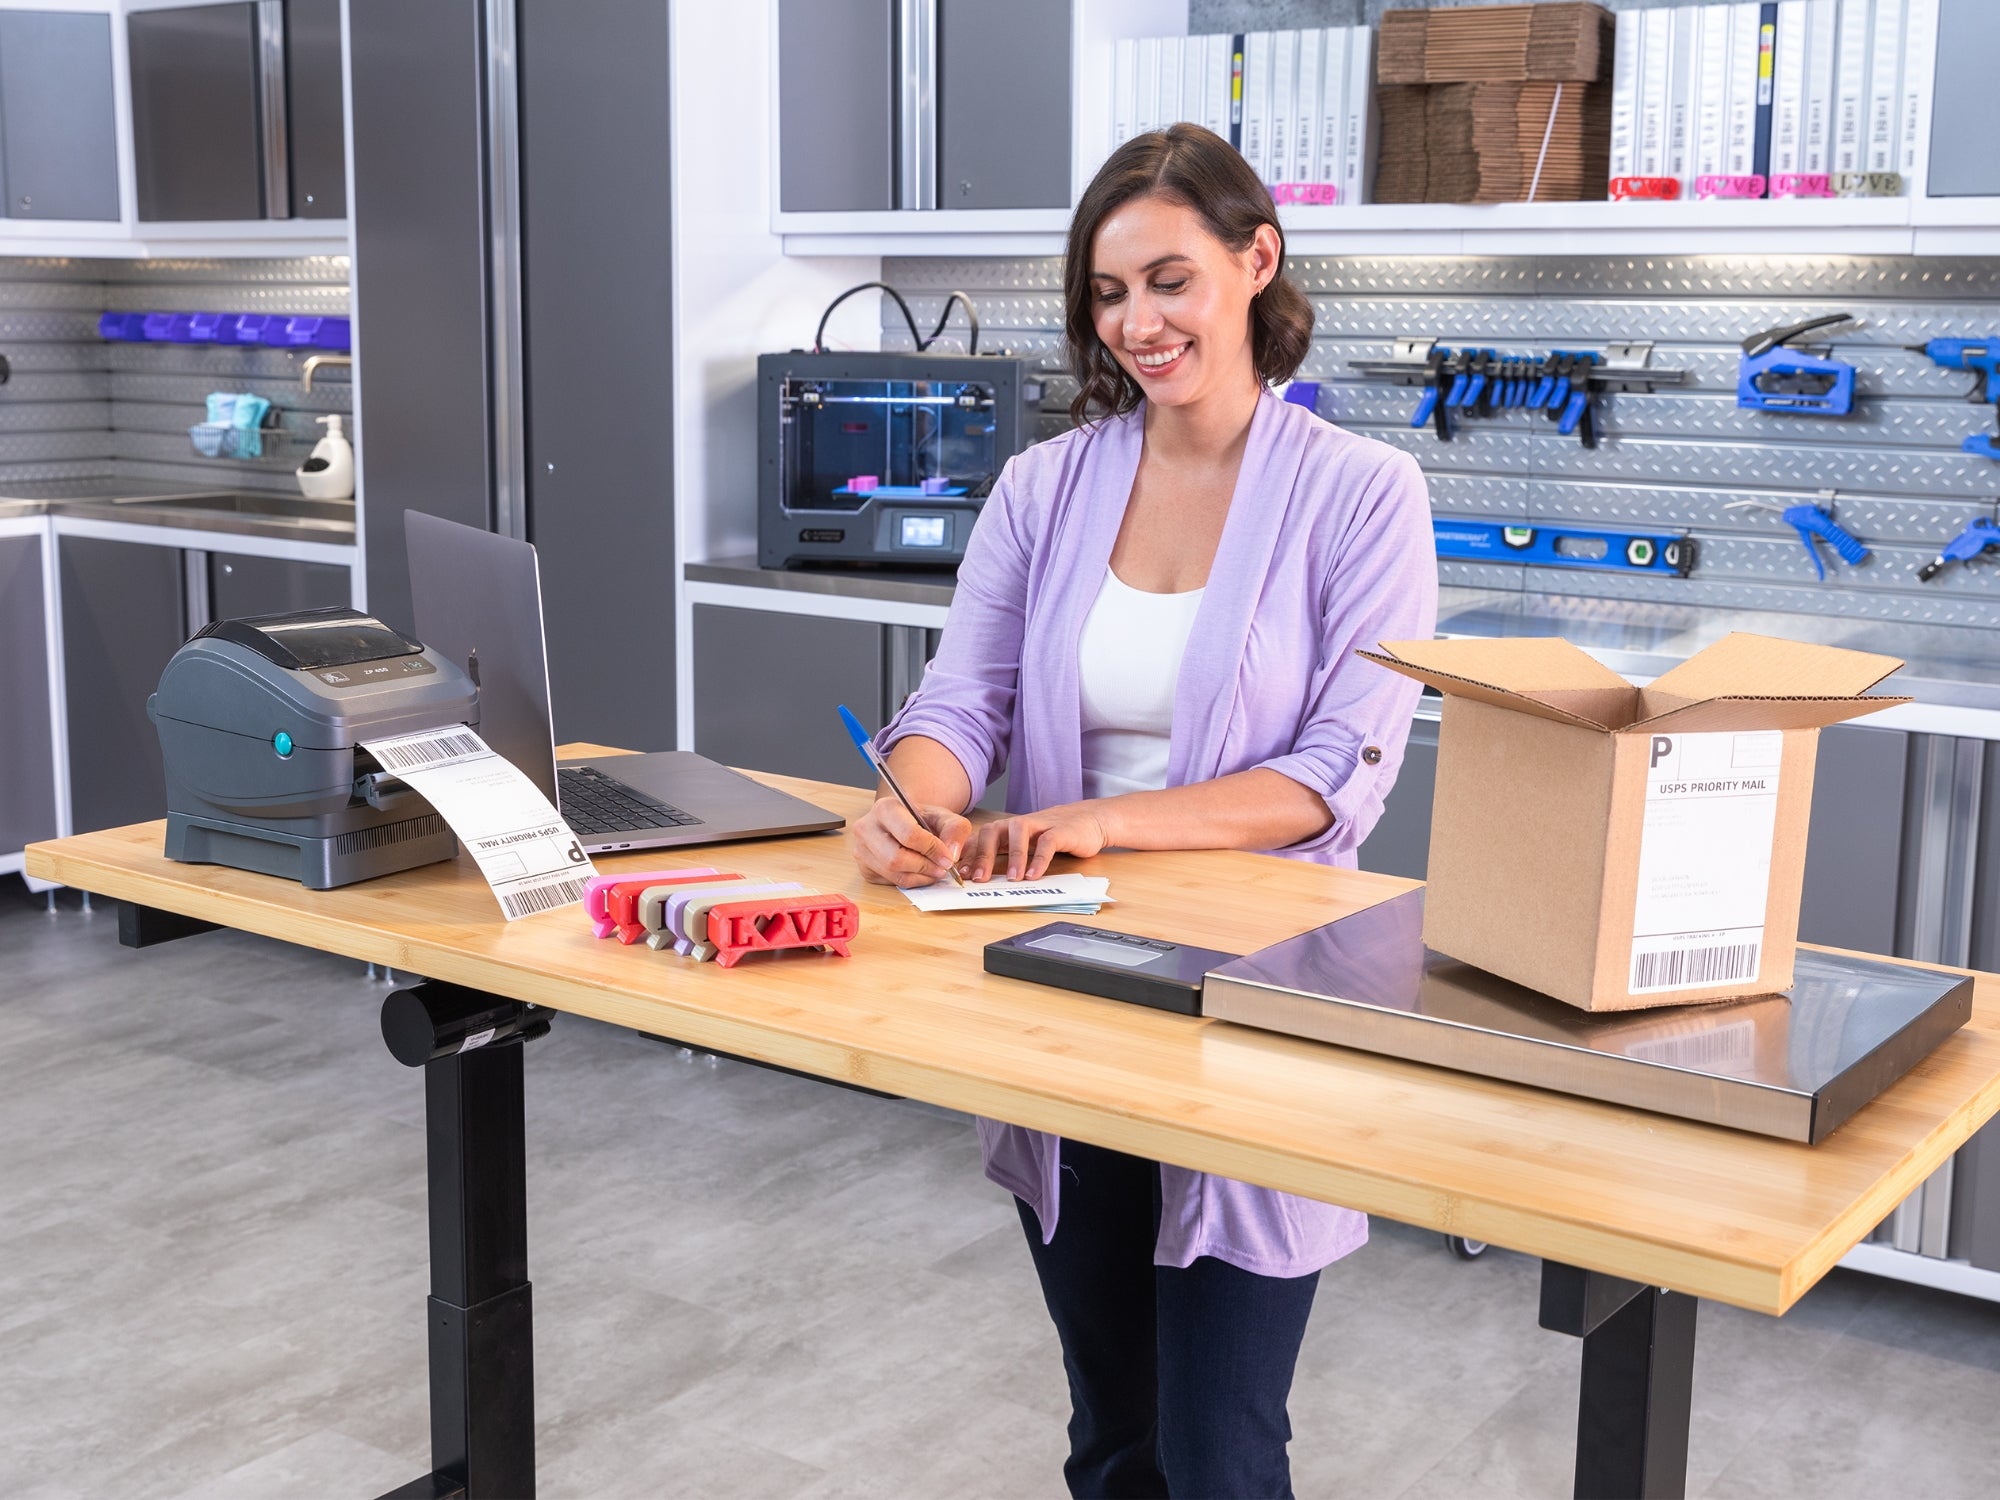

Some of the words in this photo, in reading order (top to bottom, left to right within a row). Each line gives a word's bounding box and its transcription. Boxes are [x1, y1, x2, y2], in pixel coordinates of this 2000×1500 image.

[1650, 736, 1673, 768] P
[1660, 783, 1688, 794] USPS
[1690, 781, 1739, 793] PRIORITY
[1741, 780, 1767, 790] MAIL
[500, 828, 538, 844] PRIORITY
[537, 826, 560, 838] USPS
[477, 837, 500, 848] MAIL
[567, 840, 586, 863] P
[966, 891, 1004, 899] You
[1008, 888, 1066, 897] Thank
